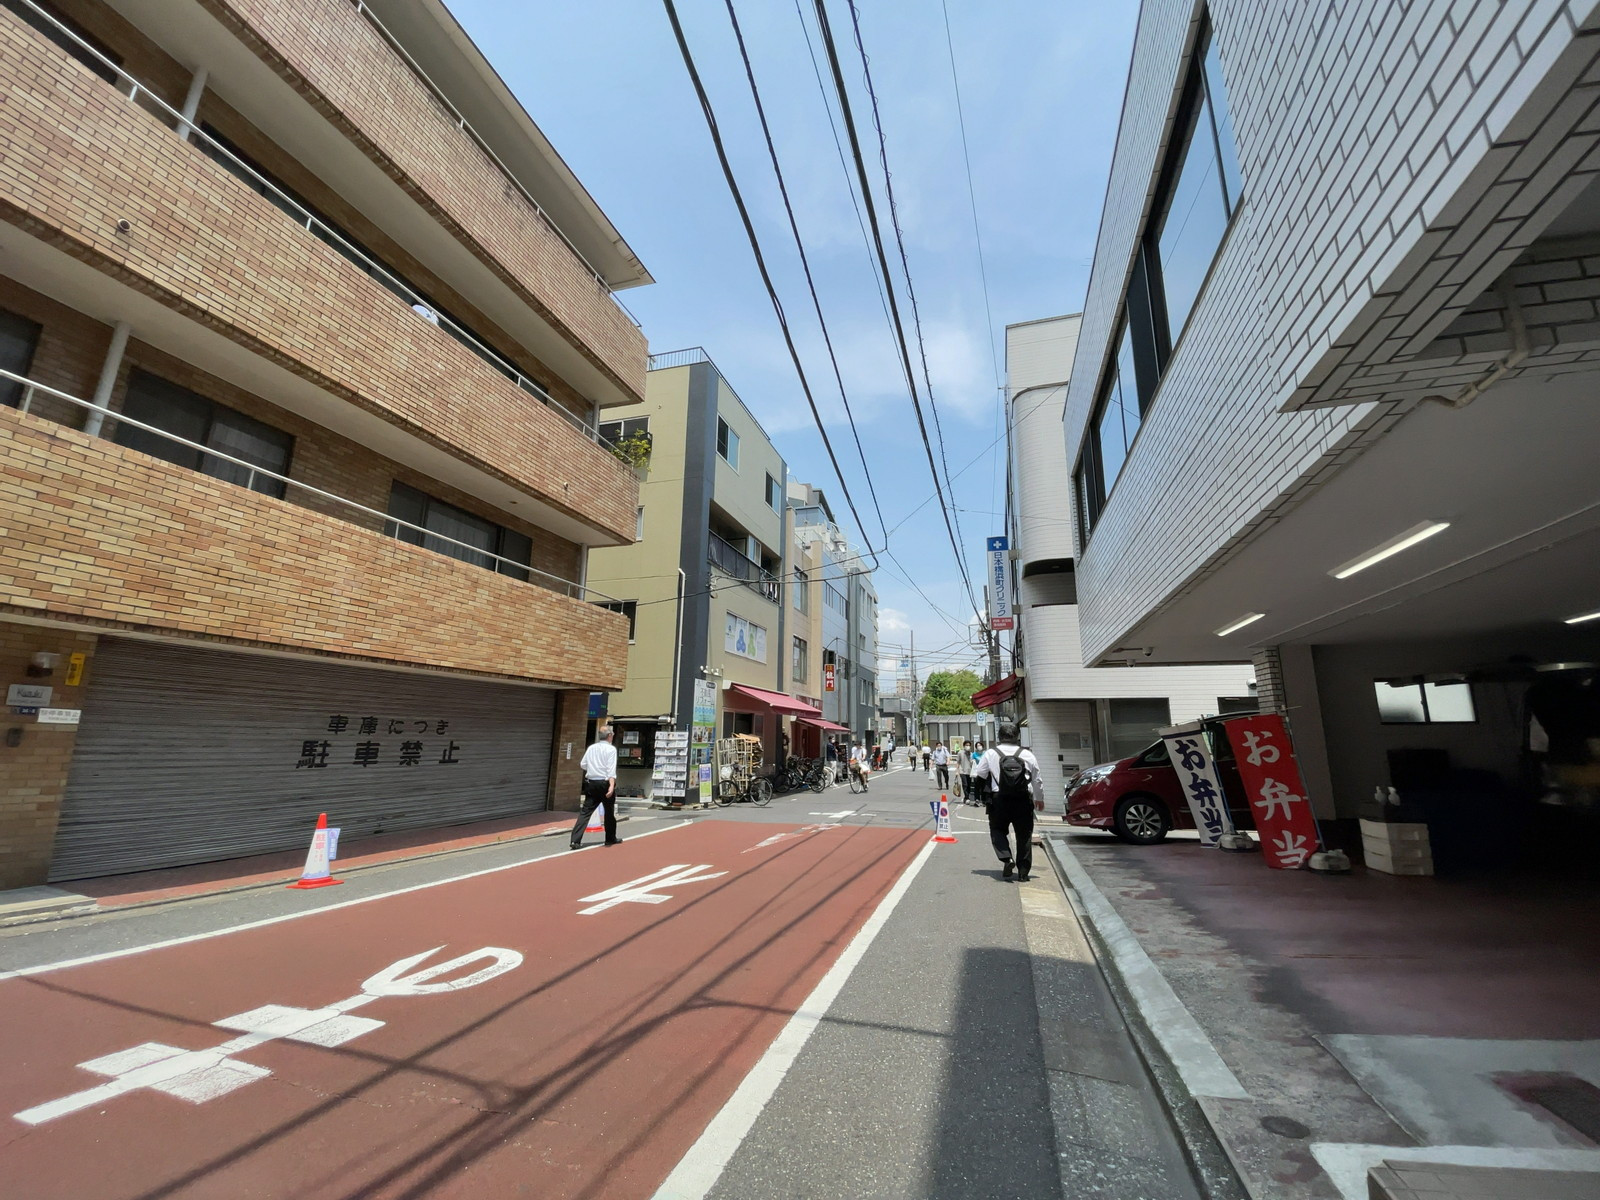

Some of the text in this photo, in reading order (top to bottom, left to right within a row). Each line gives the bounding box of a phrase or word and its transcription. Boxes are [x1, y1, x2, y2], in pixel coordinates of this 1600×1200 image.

[994, 551, 1006, 617] 日本橋浜町クリニック
[296, 740, 460, 769] 駐車禁止
[327, 714, 449, 736] 車庫につき
[1175, 739, 1224, 842] お弁当
[1242, 731, 1308, 869] お弁当
